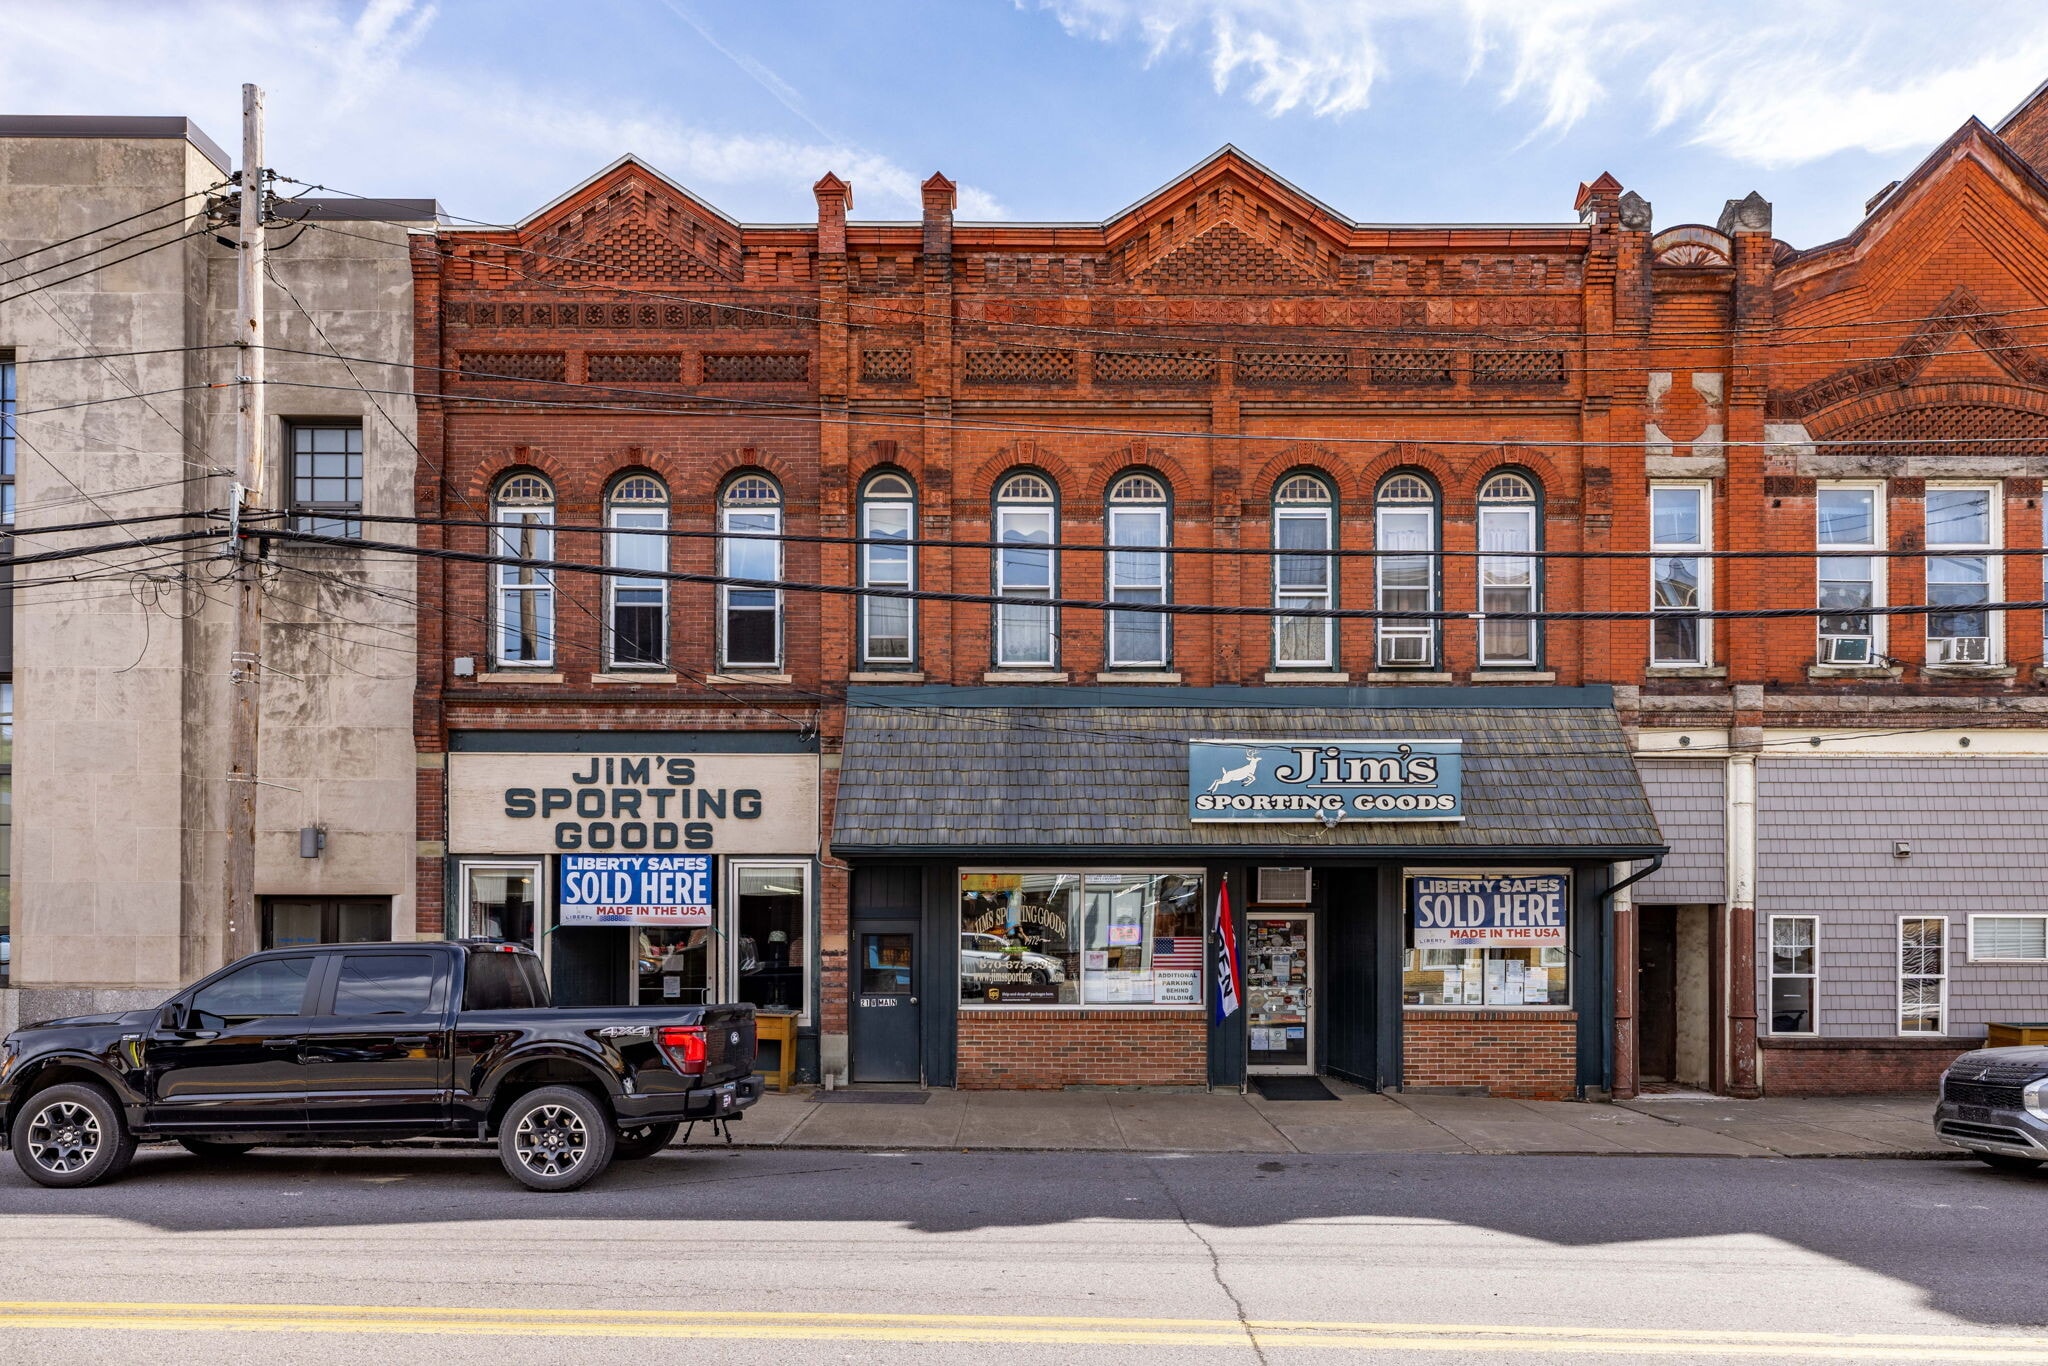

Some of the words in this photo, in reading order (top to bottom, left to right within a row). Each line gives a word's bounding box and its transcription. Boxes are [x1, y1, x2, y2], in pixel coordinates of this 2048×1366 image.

[573, 755, 696, 785] JIM'S
[1275, 743, 1438, 784] Jim's
[504, 788, 762, 819] SPORTING
[1195, 794, 1345, 810] SPORTING
[1353, 794, 1456, 810] GOODS
[555, 822, 714, 850] GOODS
[566, 857, 644, 871] LIBERTY
[648, 857, 708, 871] SAFES
[566, 871, 633, 904] SOLD
[641, 872, 707, 904] HERE
[1419, 880, 1497, 894] LIBERTY
[1500, 879, 1560, 893] SAFES
[596, 906, 634, 916] MADE
[637, 906, 649, 916] IN
[653, 906, 678, 916] THE
[680, 906, 706, 916] USA
[995, 905, 1038, 926] SPOING
[1037, 907, 1067, 939] GOODS
[1419, 894, 1486, 928] SOLD
[1493, 893, 1561, 927] HERE
[1450, 929, 1486, 939] MADE
[1490, 929, 1502, 938] IN
[1506, 928, 1532, 938] THE
[1534, 928, 1560, 938] USA
[979, 960, 1060, 970] 570-673-33
